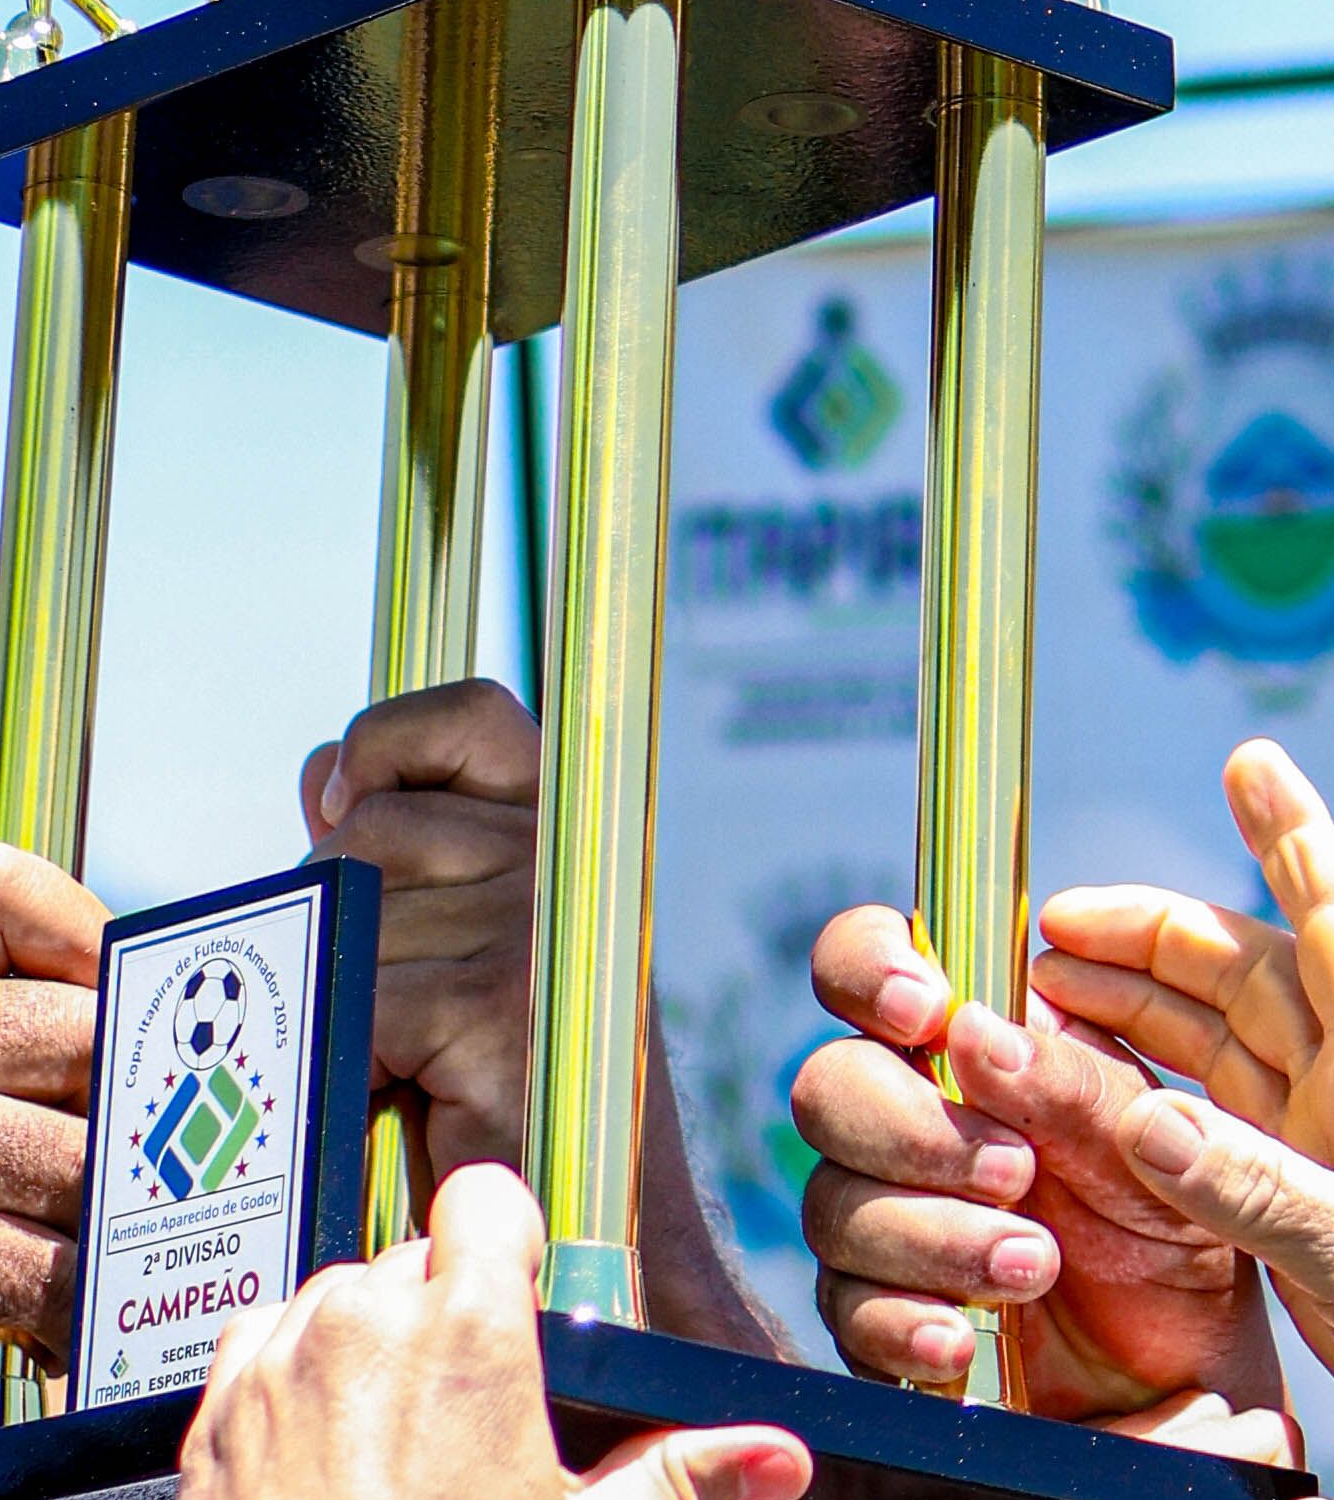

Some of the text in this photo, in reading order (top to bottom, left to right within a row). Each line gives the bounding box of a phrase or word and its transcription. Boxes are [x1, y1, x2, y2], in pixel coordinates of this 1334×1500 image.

[125, 935, 288, 1089] Copa Itapira de Futebol Amador 2025
[160, 1206, 219, 1231] Aparecido
[223, 1199, 237, 1215] de
[240, 1190, 280, 1212] Godoy
[165, 1232, 241, 1271] DIVISÃO
[118, 1267, 260, 1334] CAMPEÃO
[95, 1380, 141, 1405] ITAPIRA
